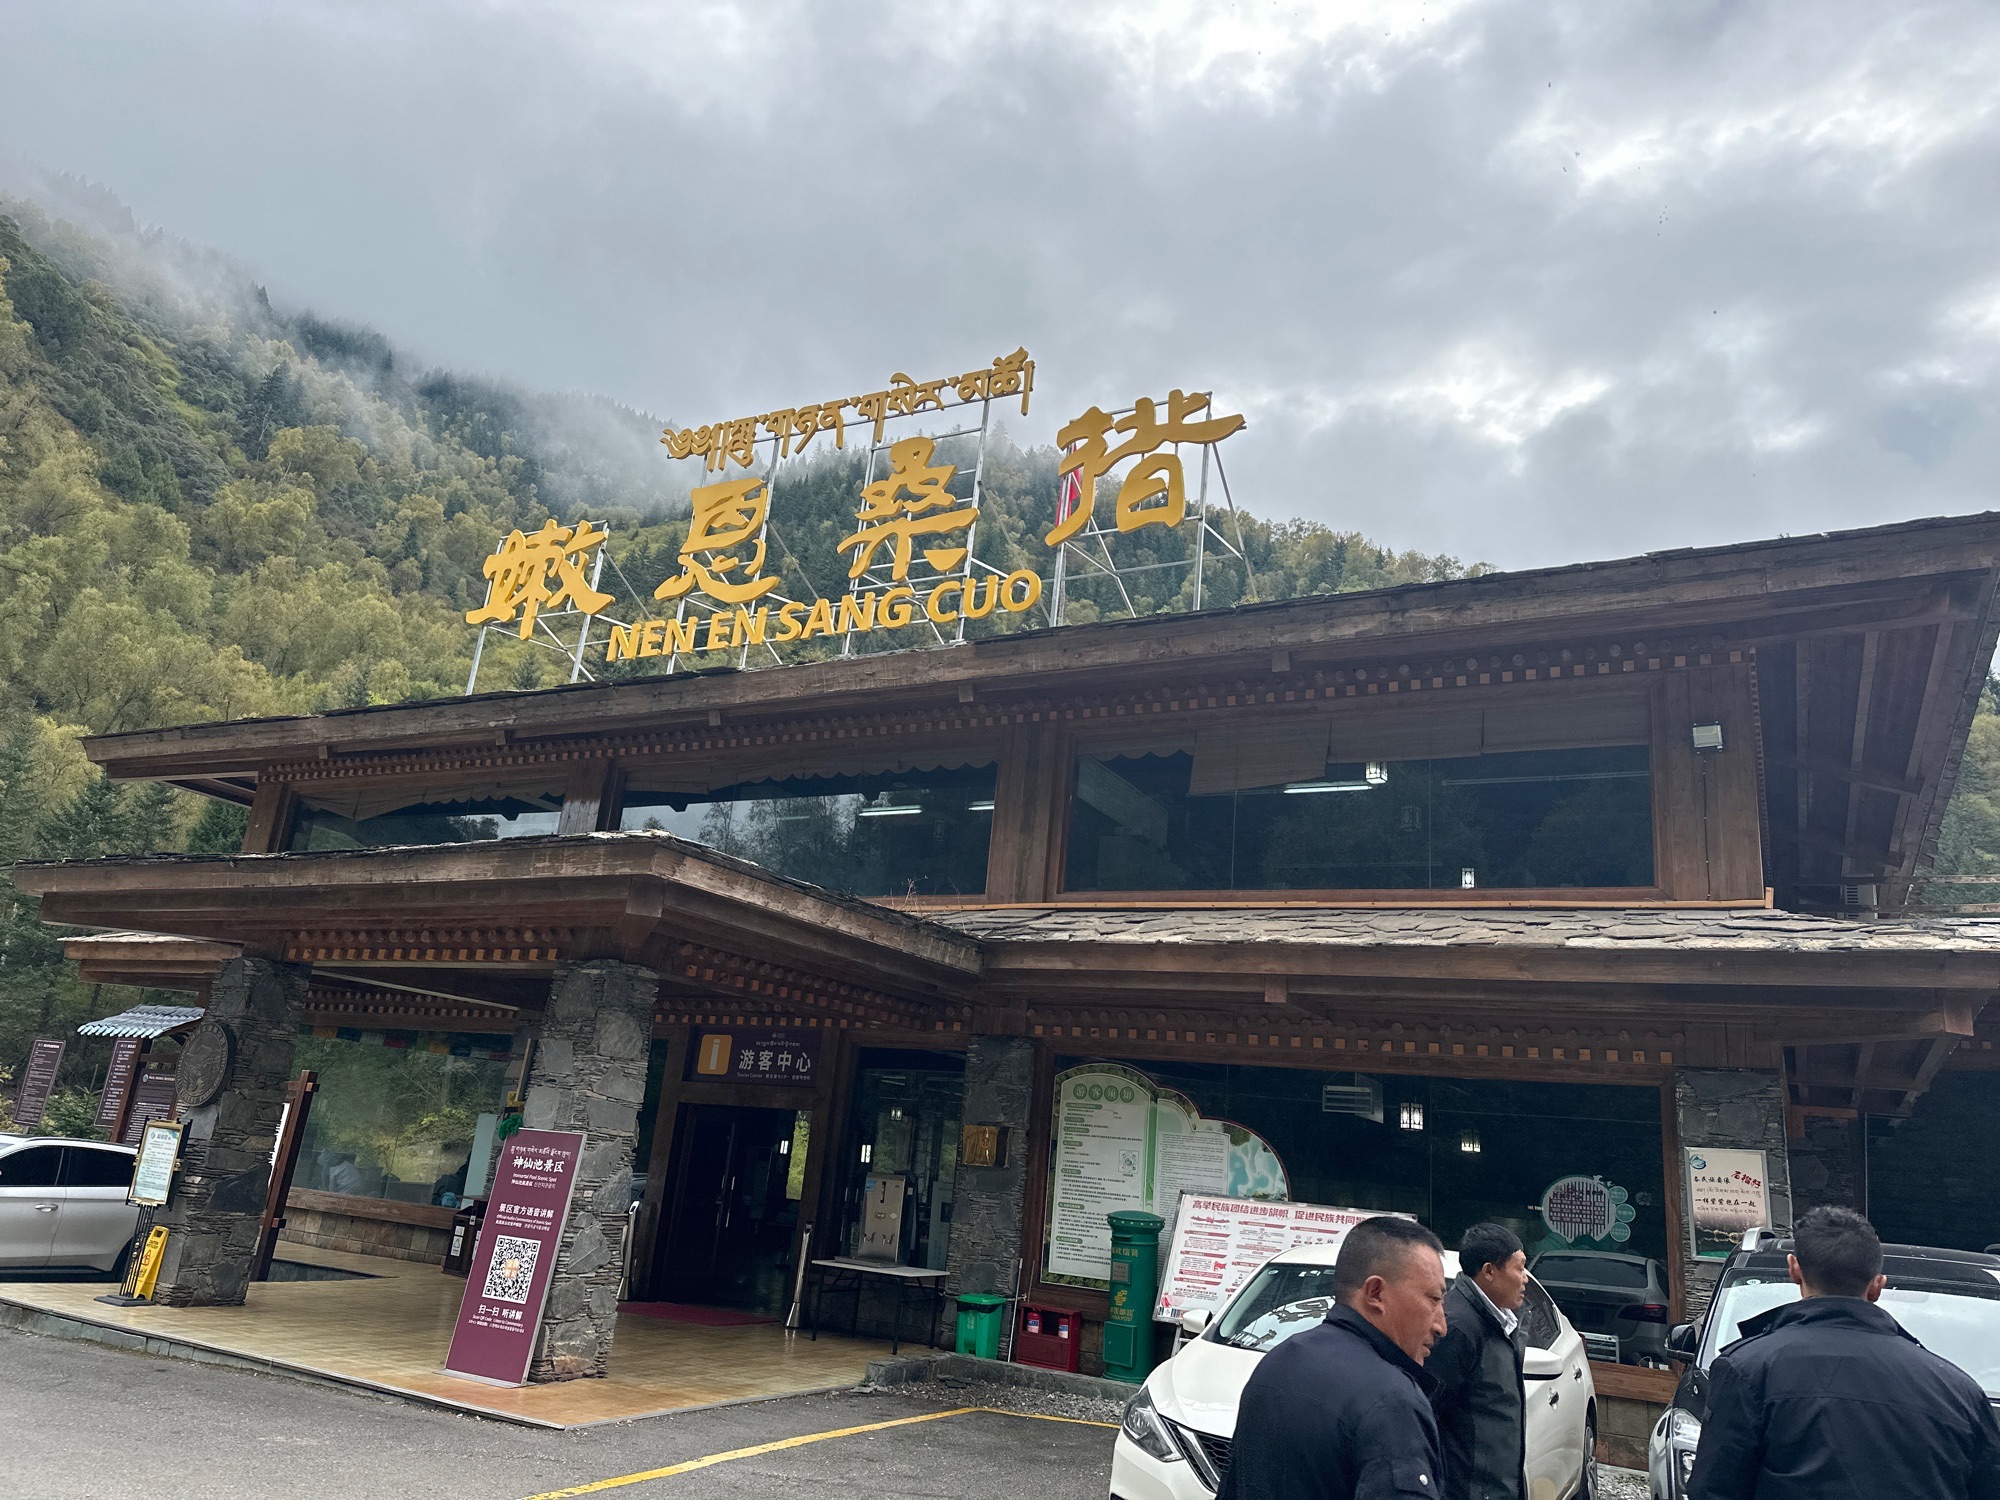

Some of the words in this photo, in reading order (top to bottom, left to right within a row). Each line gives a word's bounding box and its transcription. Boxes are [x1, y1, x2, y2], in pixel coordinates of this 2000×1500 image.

[466, 389, 1246, 641] 嫩恩桑措
[606, 616, 698, 662] NEN
[706, 608, 766, 652] EN
[776, 586, 914, 642] SANG
[927, 569, 1042, 625] CUO
[739, 1049, 810, 1072] 游客中心
[512, 1156, 565, 1173] 神仙池景区
[1730, 1170, 1762, 1189] 石榴籽
[499, 1204, 554, 1218] 景区官方语音讲解
[1192, 1199, 1289, 1219] 高举民族团结进步旗帜
[1695, 1197, 1757, 1208] 一样紧紧抱在一起
[478, 1304, 499, 1316] 扫一扫
[502, 1308, 523, 1320] 听讲解
